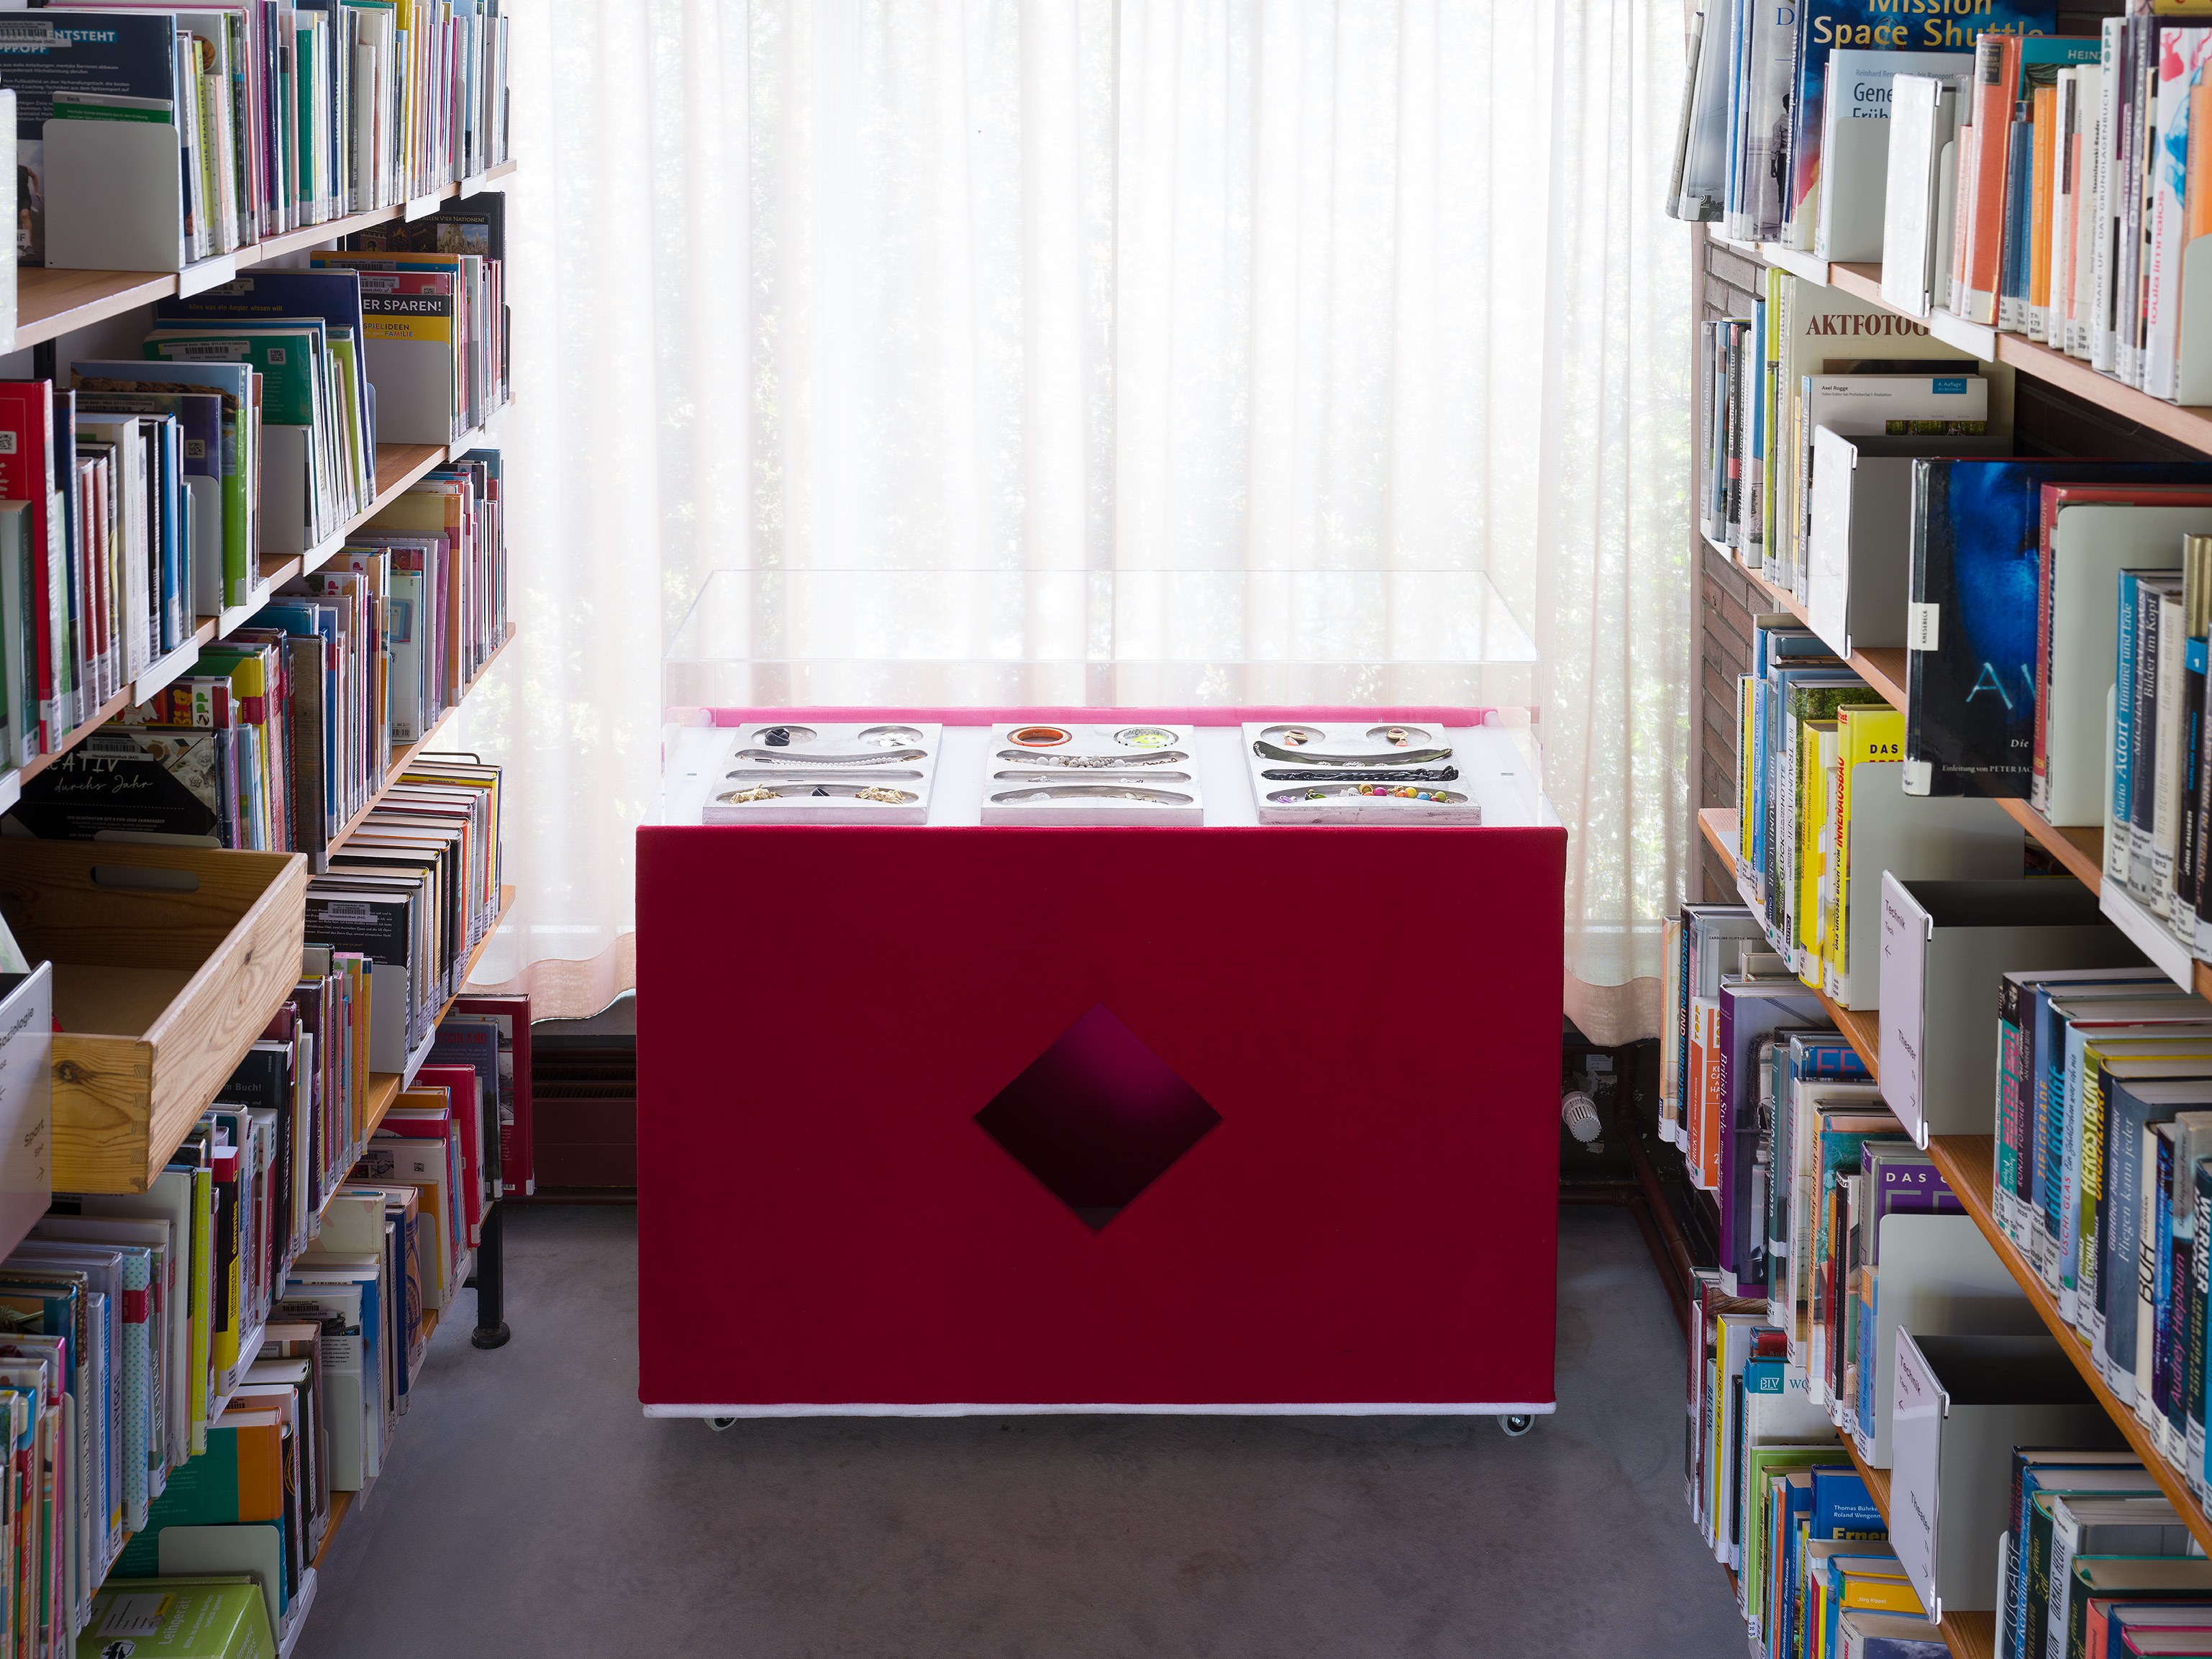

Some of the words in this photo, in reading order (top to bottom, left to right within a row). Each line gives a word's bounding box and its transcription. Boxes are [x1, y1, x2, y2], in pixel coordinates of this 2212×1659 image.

[1790, 29, 1799, 76] Shuttle
[1814, 16, 1908, 49] Space
[2103, 25, 2112, 75] TOPP
[1788, 77, 1797, 114] Space
[1785, 116, 1794, 164] Mission
[2099, 88, 2111, 212] GRUNDLAGENBUCH
[383, 299, 442, 312] SPAREN!
[2149, 283, 2159, 326] toula
[46, 468, 55, 517] 2024
[2122, 602, 2132, 631] Erde
[2146, 597, 2158, 629] Kopf
[2122, 633, 2131, 659] und
[2147, 632, 2156, 653] im
[2120, 662, 2131, 713] Himmel
[2144, 656, 2154, 698] Bilder
[1870, 744, 1898, 754] DAS
[2011, 739, 2029, 748] Die
[2116, 718, 2129, 779] Adorf
[1942, 765, 1975, 774] Einleitung
[1836, 756, 1846, 848] INNENAUSBAU
[1885, 899, 1906, 931] Technik
[1885, 920, 1894, 936] Tech
[1898, 1028, 1916, 1061] Theater
[235, 1082, 262, 1092] Buch!
[2047, 1060, 2065, 1155] GEORGE
[24, 1118, 45, 1147] Sport
[2121, 1117, 2135, 1159] jeder
[1886, 1172, 1926, 1183] DAS
[2064, 1157, 2073, 1171] Ein
[2110, 1158, 2119, 1195] Maria
[2119, 1161, 2132, 1201] kann
[2063, 1176, 2072, 1211] GLAS
[2062, 1214, 2070, 1256] USCHI
[2108, 1199, 2118, 1252] Günther
[2118, 1204, 2134, 1263] Fliegen
[2196, 1197, 2211, 1294] WERNER
[2139, 1240, 2155, 1306] BUH
[2172, 1253, 2185, 1337] Hepburn
[1899, 1353, 1921, 1397] Technik
[1899, 1374, 1909, 1395] Tech
[2170, 1338, 2183, 1408] Audrey
[1910, 1490, 1931, 1535] Theater
[2004, 1537, 2020, 1647] ZUGABE
[158, 1596, 193, 1646] Leihgerät!
